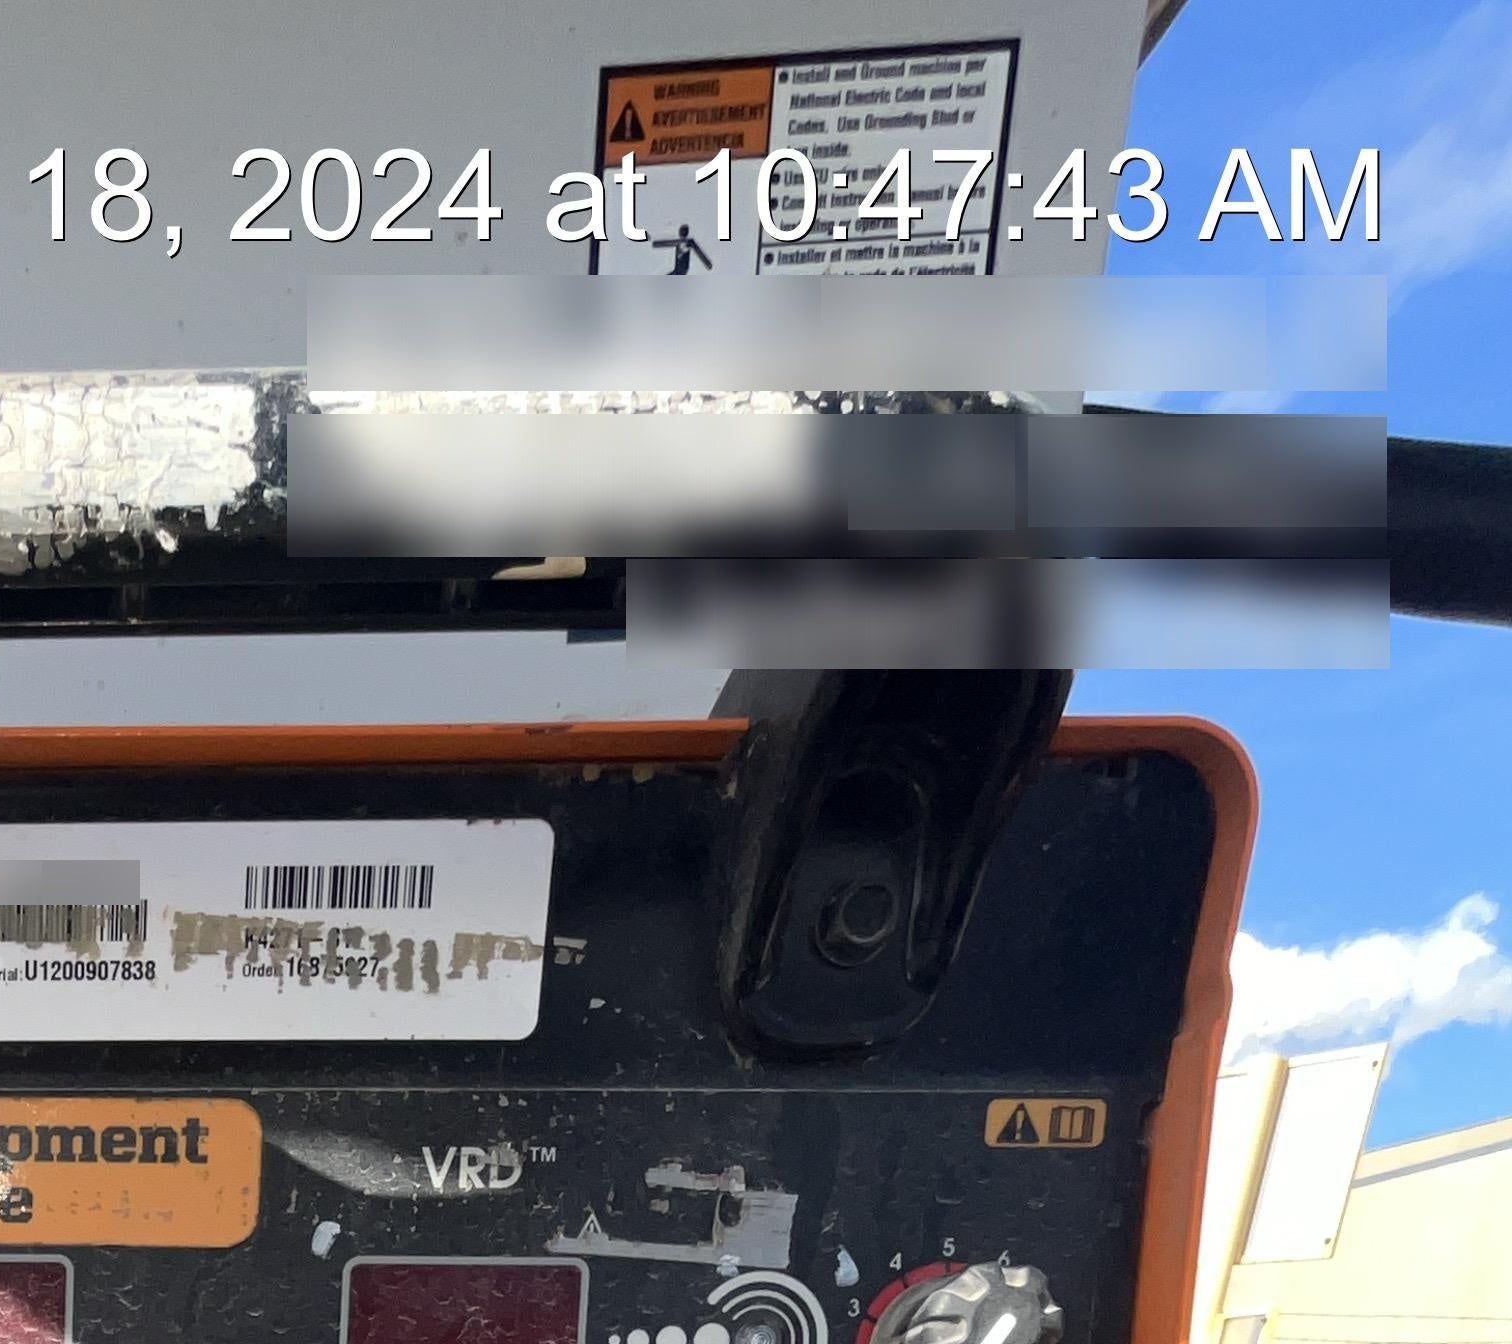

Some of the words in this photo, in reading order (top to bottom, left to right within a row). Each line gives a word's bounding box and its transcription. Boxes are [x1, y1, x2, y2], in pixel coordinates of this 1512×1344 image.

[25, 960, 156, 982] U1200907838
[942, 1238, 956, 1257] 5
[888, 1252, 902, 1271] 4
[998, 1250, 1011, 1267] 6
[847, 1298, 860, 1317] 3
